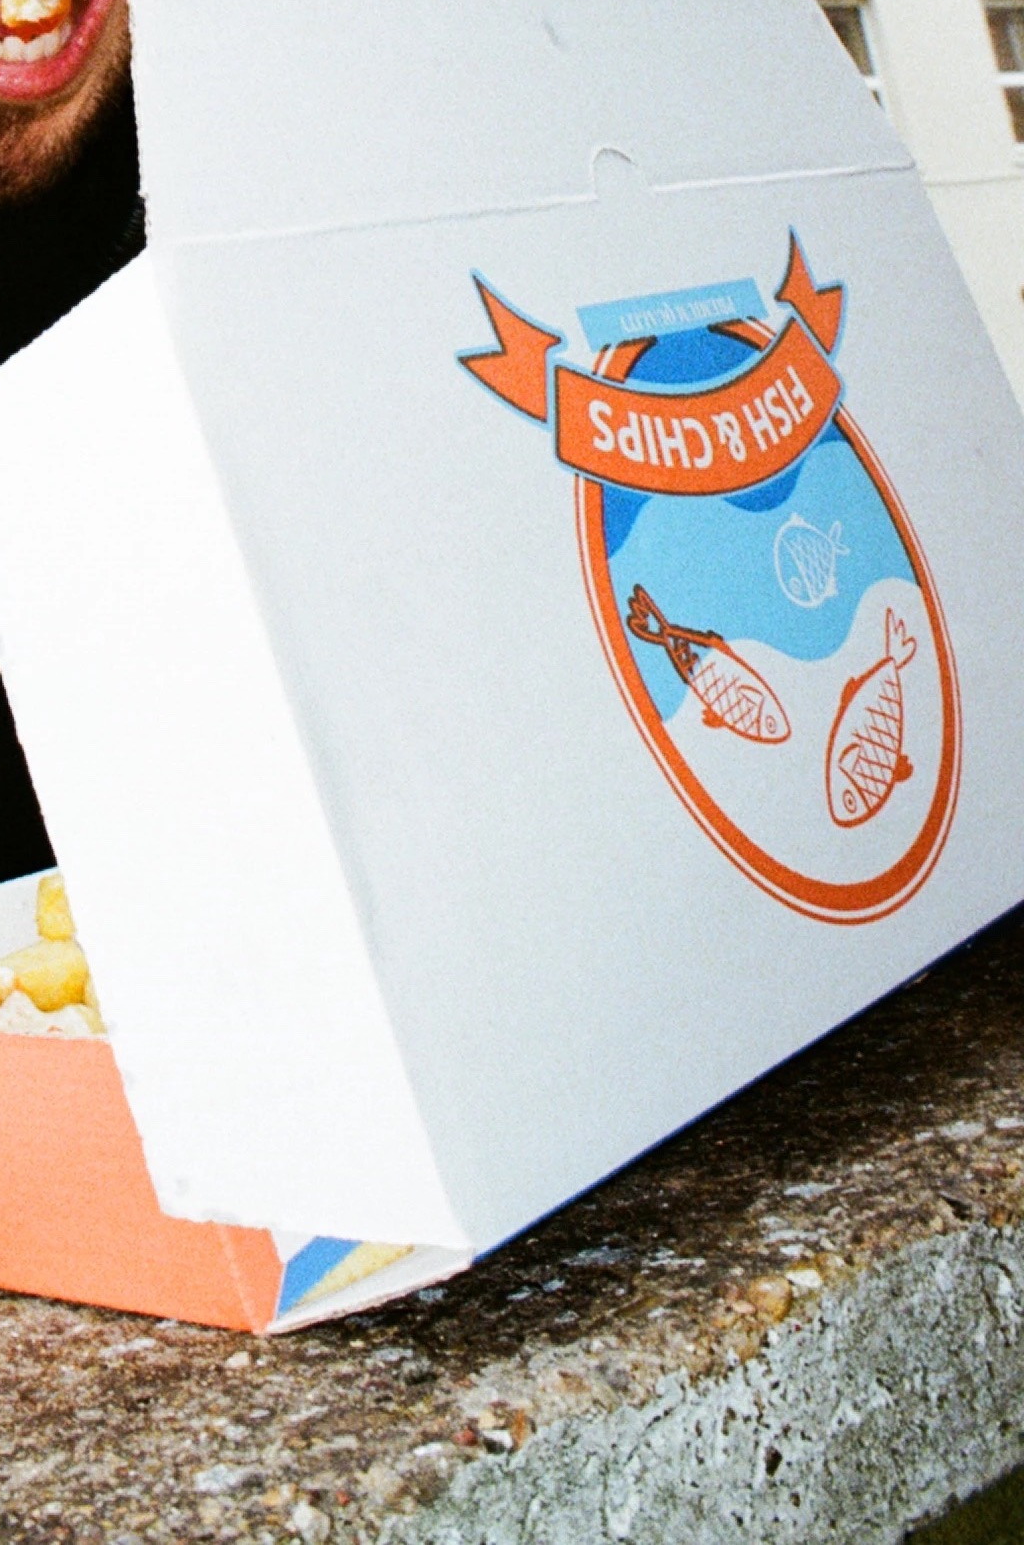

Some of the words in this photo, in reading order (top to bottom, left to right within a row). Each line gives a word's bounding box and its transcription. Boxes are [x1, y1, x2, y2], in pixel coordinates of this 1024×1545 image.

[588, 399, 714, 470] CHIPS
[710, 411, 747, 463] &
[741, 364, 815, 452] FISH
